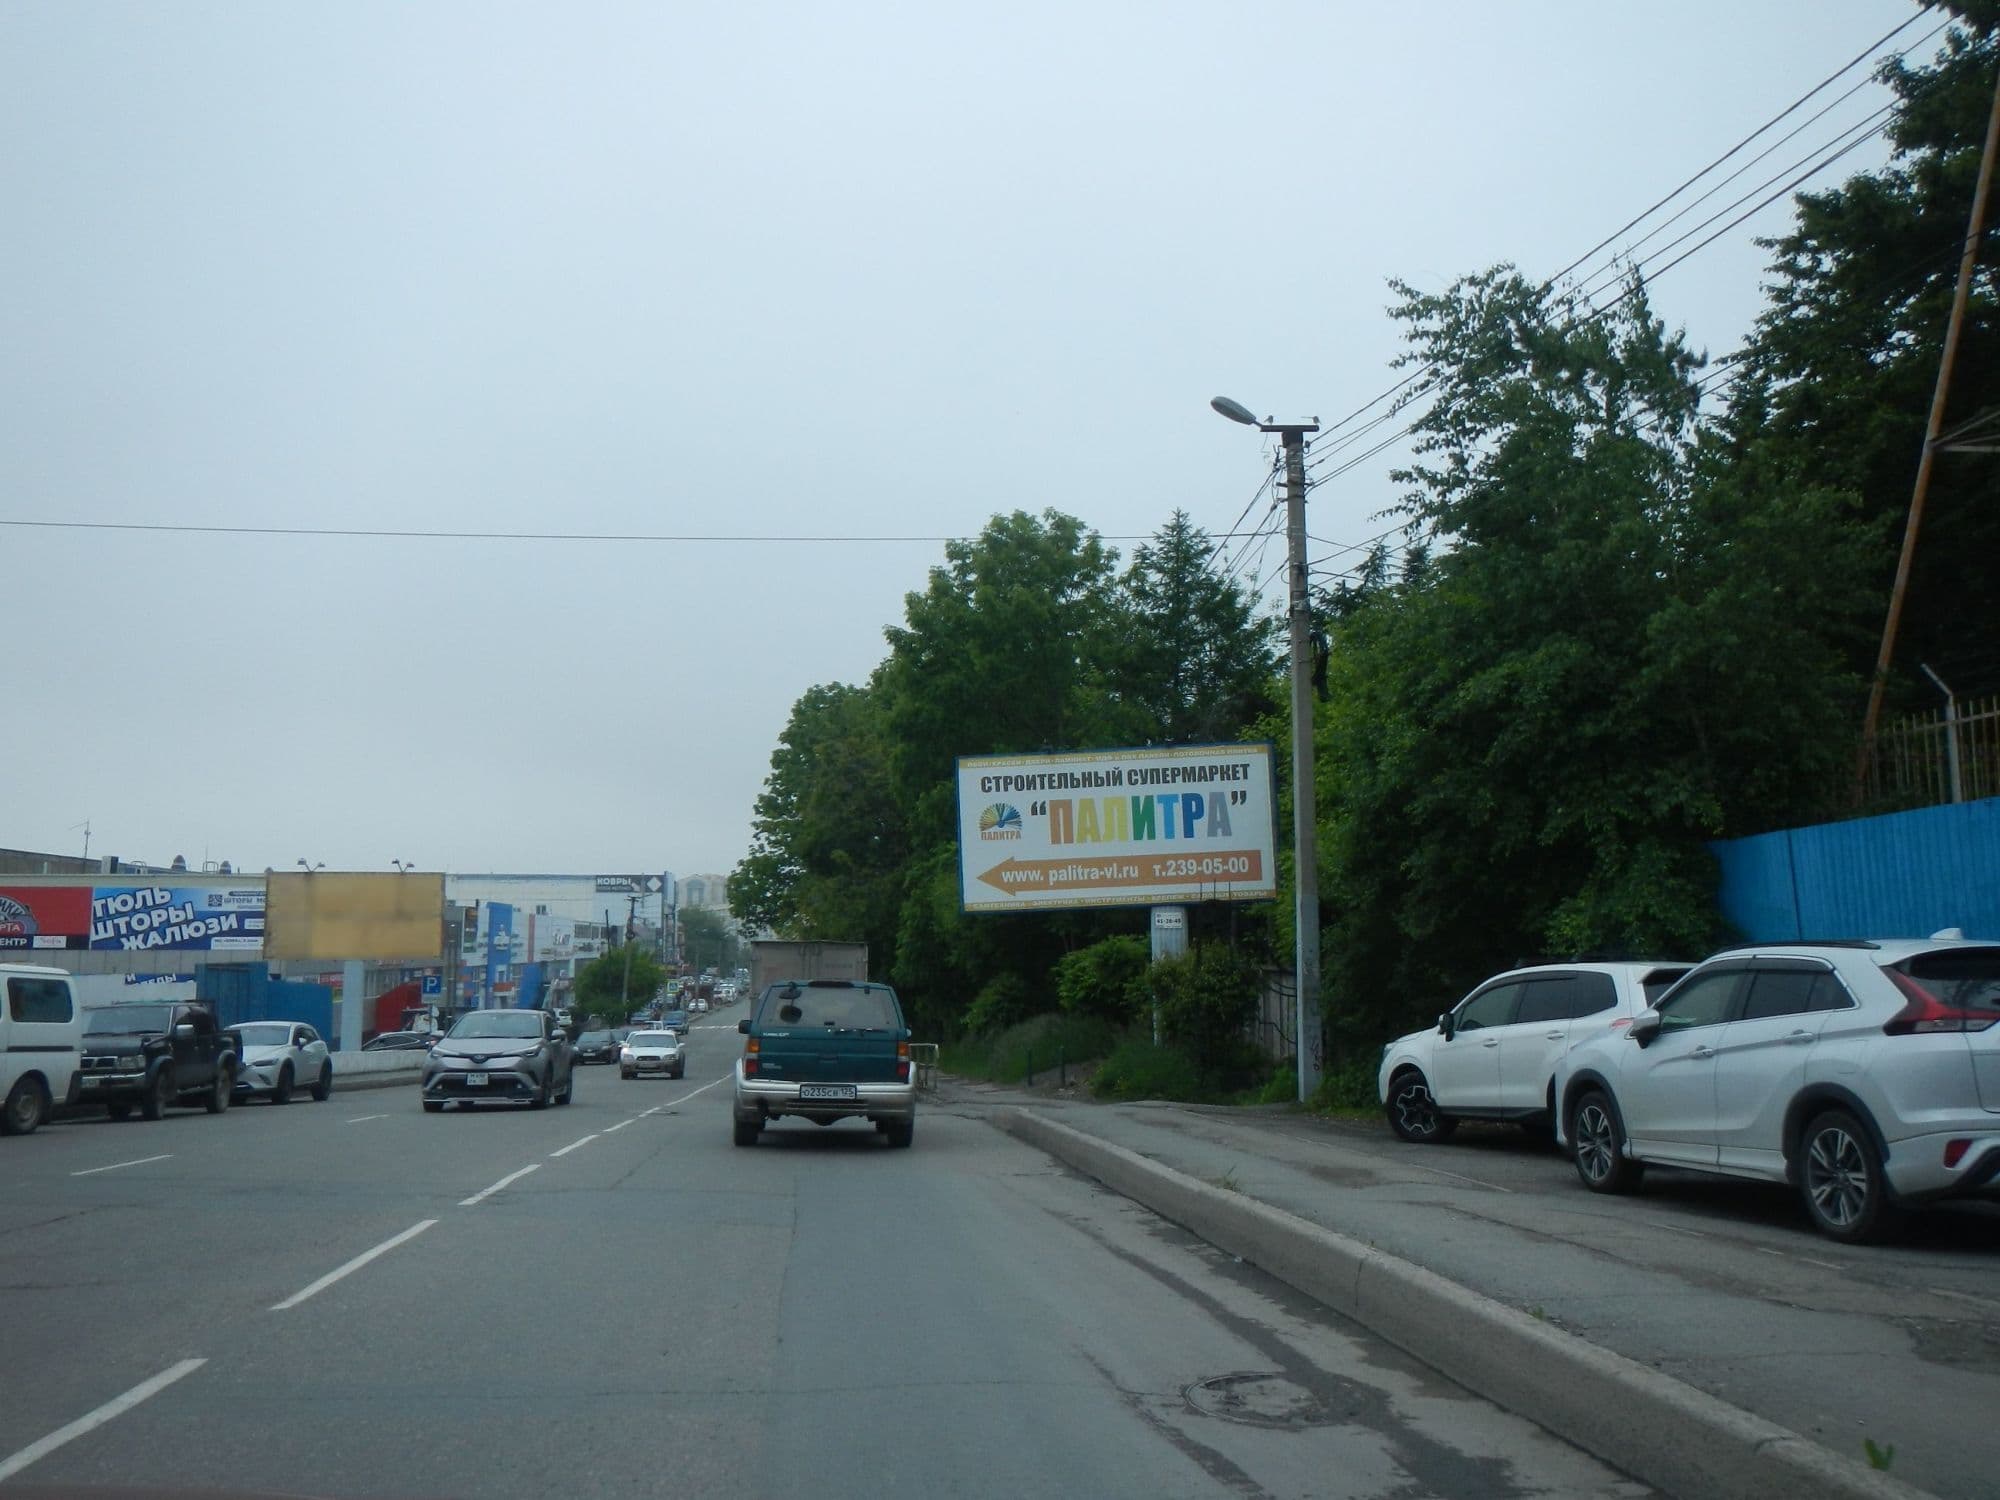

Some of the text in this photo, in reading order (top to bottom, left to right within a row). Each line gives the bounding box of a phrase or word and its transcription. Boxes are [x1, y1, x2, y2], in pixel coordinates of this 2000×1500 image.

[980, 763, 1250, 793] СТРОИТЕЛЬНЫЙ СУПЕРМАРКЕТ
[981, 830, 1022, 841] ПАЛИТРА
[93, 888, 172, 917] ТЮЛЬ
[91, 903, 194, 941] ШТОРЫ
[120, 913, 238, 950] ЖАЛЮЗИ
